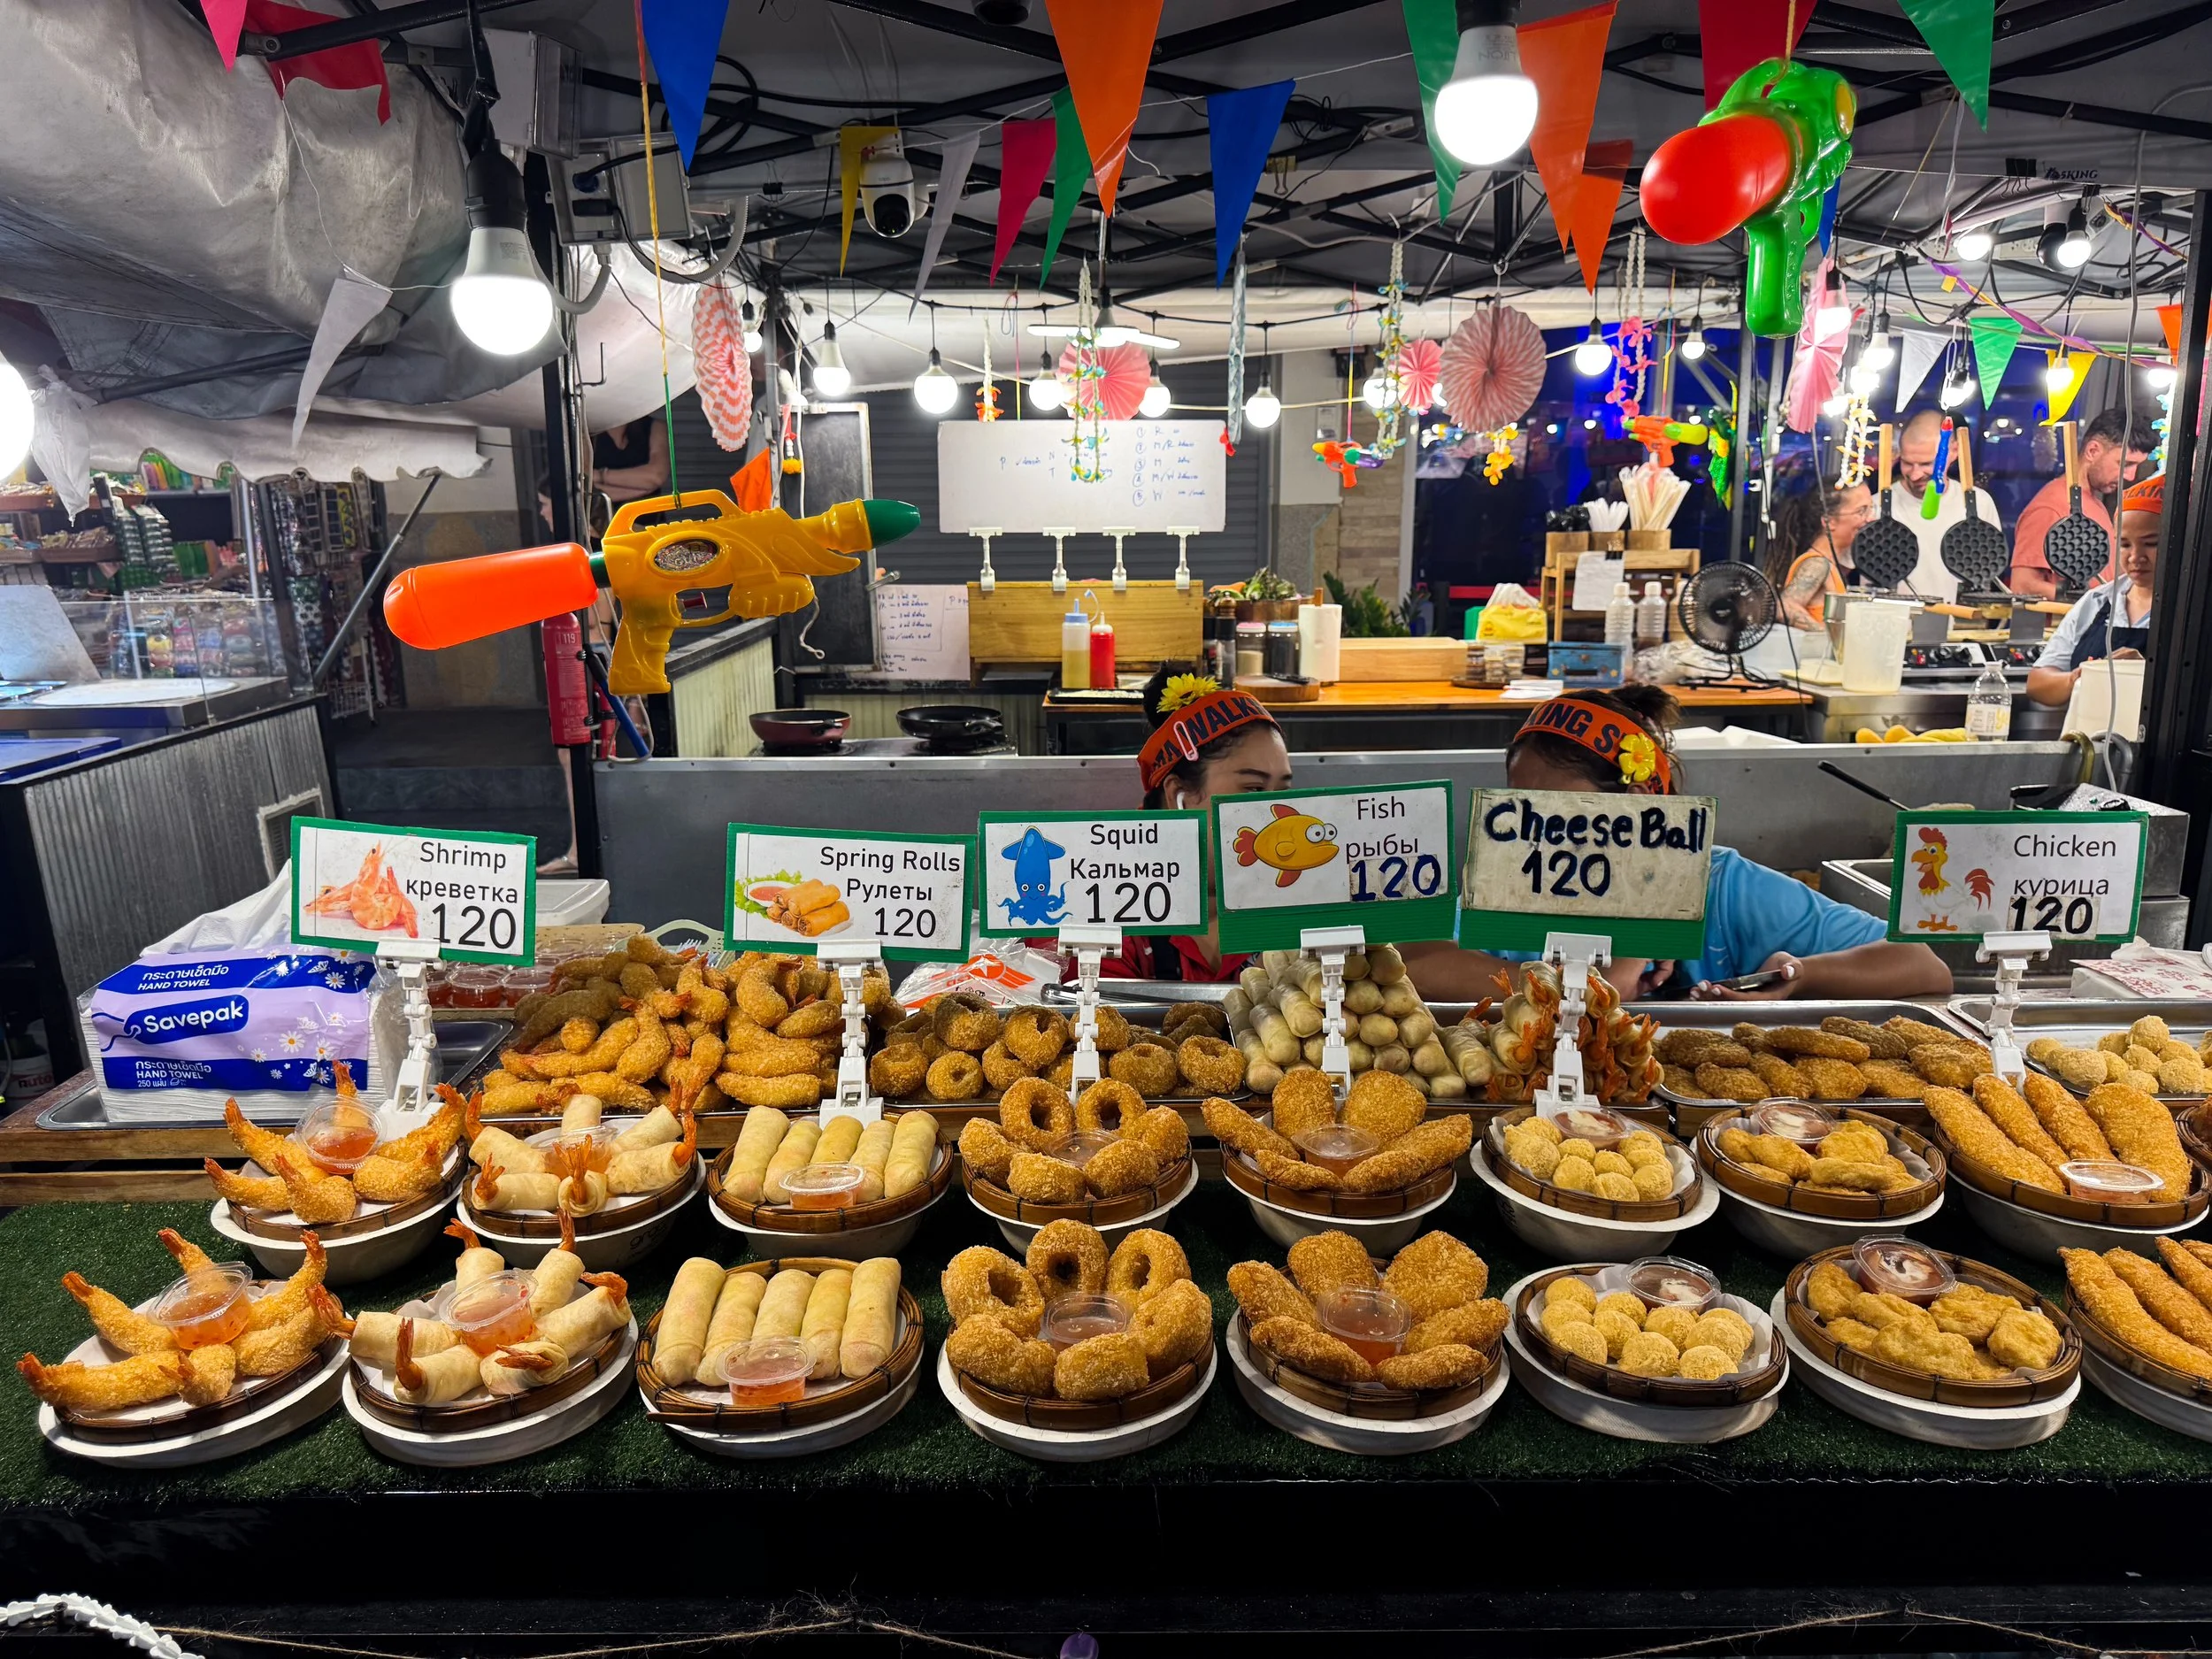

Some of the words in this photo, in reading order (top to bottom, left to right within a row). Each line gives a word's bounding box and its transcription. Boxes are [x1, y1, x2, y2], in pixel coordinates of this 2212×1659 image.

[1357, 796, 1405, 820] Fish
[1090, 823, 1158, 850] Squid
[1485, 798, 1633, 848] Cheese
[1640, 807, 1707, 854] Ball
[419, 841, 506, 873] Shrimp
[1346, 833, 1418, 864] рыбы
[2014, 834, 2116, 857] Chicken
[820, 846, 894, 873] Spring
[903, 850, 960, 872] Rolls
[1071, 858, 1180, 883] Кальмар
[1351, 854, 1441, 902] 120
[1522, 850, 1610, 897] 120
[406, 879, 518, 903] креветка
[847, 878, 932, 902] Рулеты
[2014, 879, 2109, 897] курица
[1085, 882, 1171, 924] 120
[2011, 896, 2093, 934] 120
[432, 902, 517, 949] 120
[874, 907, 936, 938] 120
[137, 981, 171, 991] HAND
[173, 979, 211, 988] TOWEL
[142, 964, 229, 981] กระดาษเช็ดมือ
[143, 1000, 243, 1033] Savepak
[136, 1070, 167, 1079] HAND
[168, 1071, 204, 1079] TOWEL
